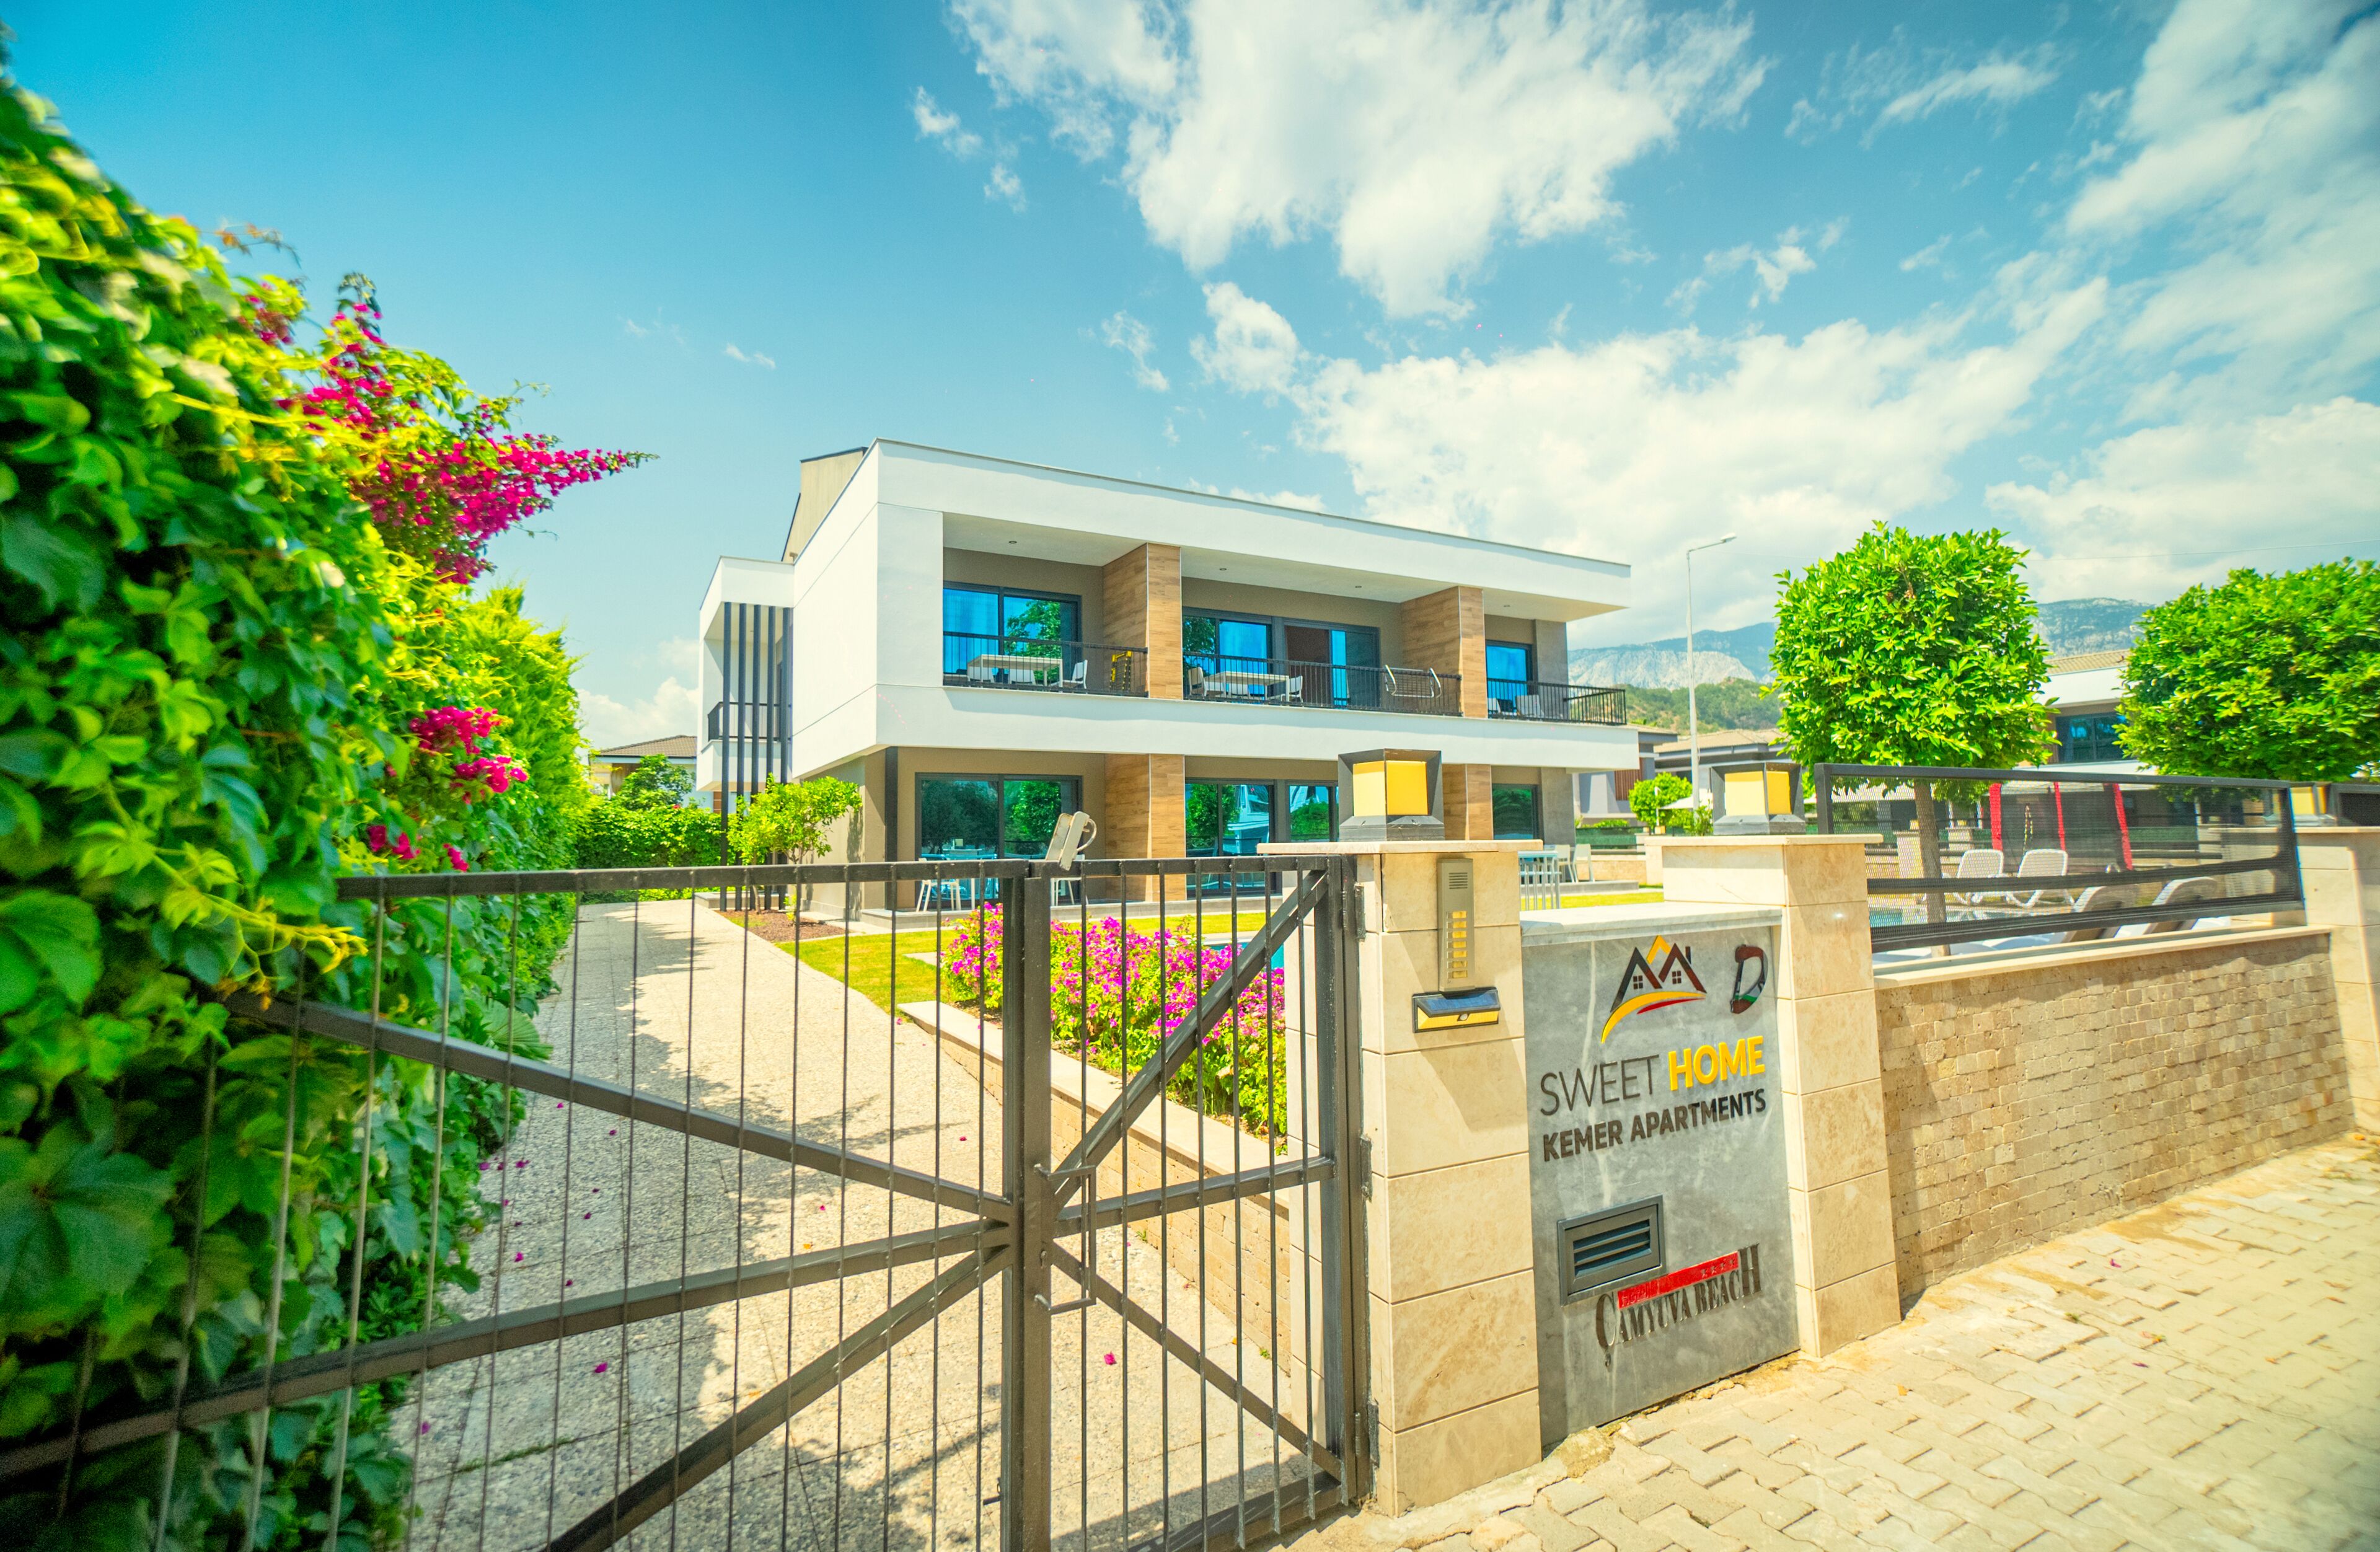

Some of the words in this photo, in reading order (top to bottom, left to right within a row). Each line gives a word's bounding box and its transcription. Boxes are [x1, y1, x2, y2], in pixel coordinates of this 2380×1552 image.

[1540, 1054, 1660, 1116] SWEET
[1668, 1035, 1765, 1091] HOME
[1543, 1120, 1623, 1162] KEMER
[1631, 1088, 1766, 1142] APARTMENTS
[1693, 1243, 1762, 1316] BEACH
